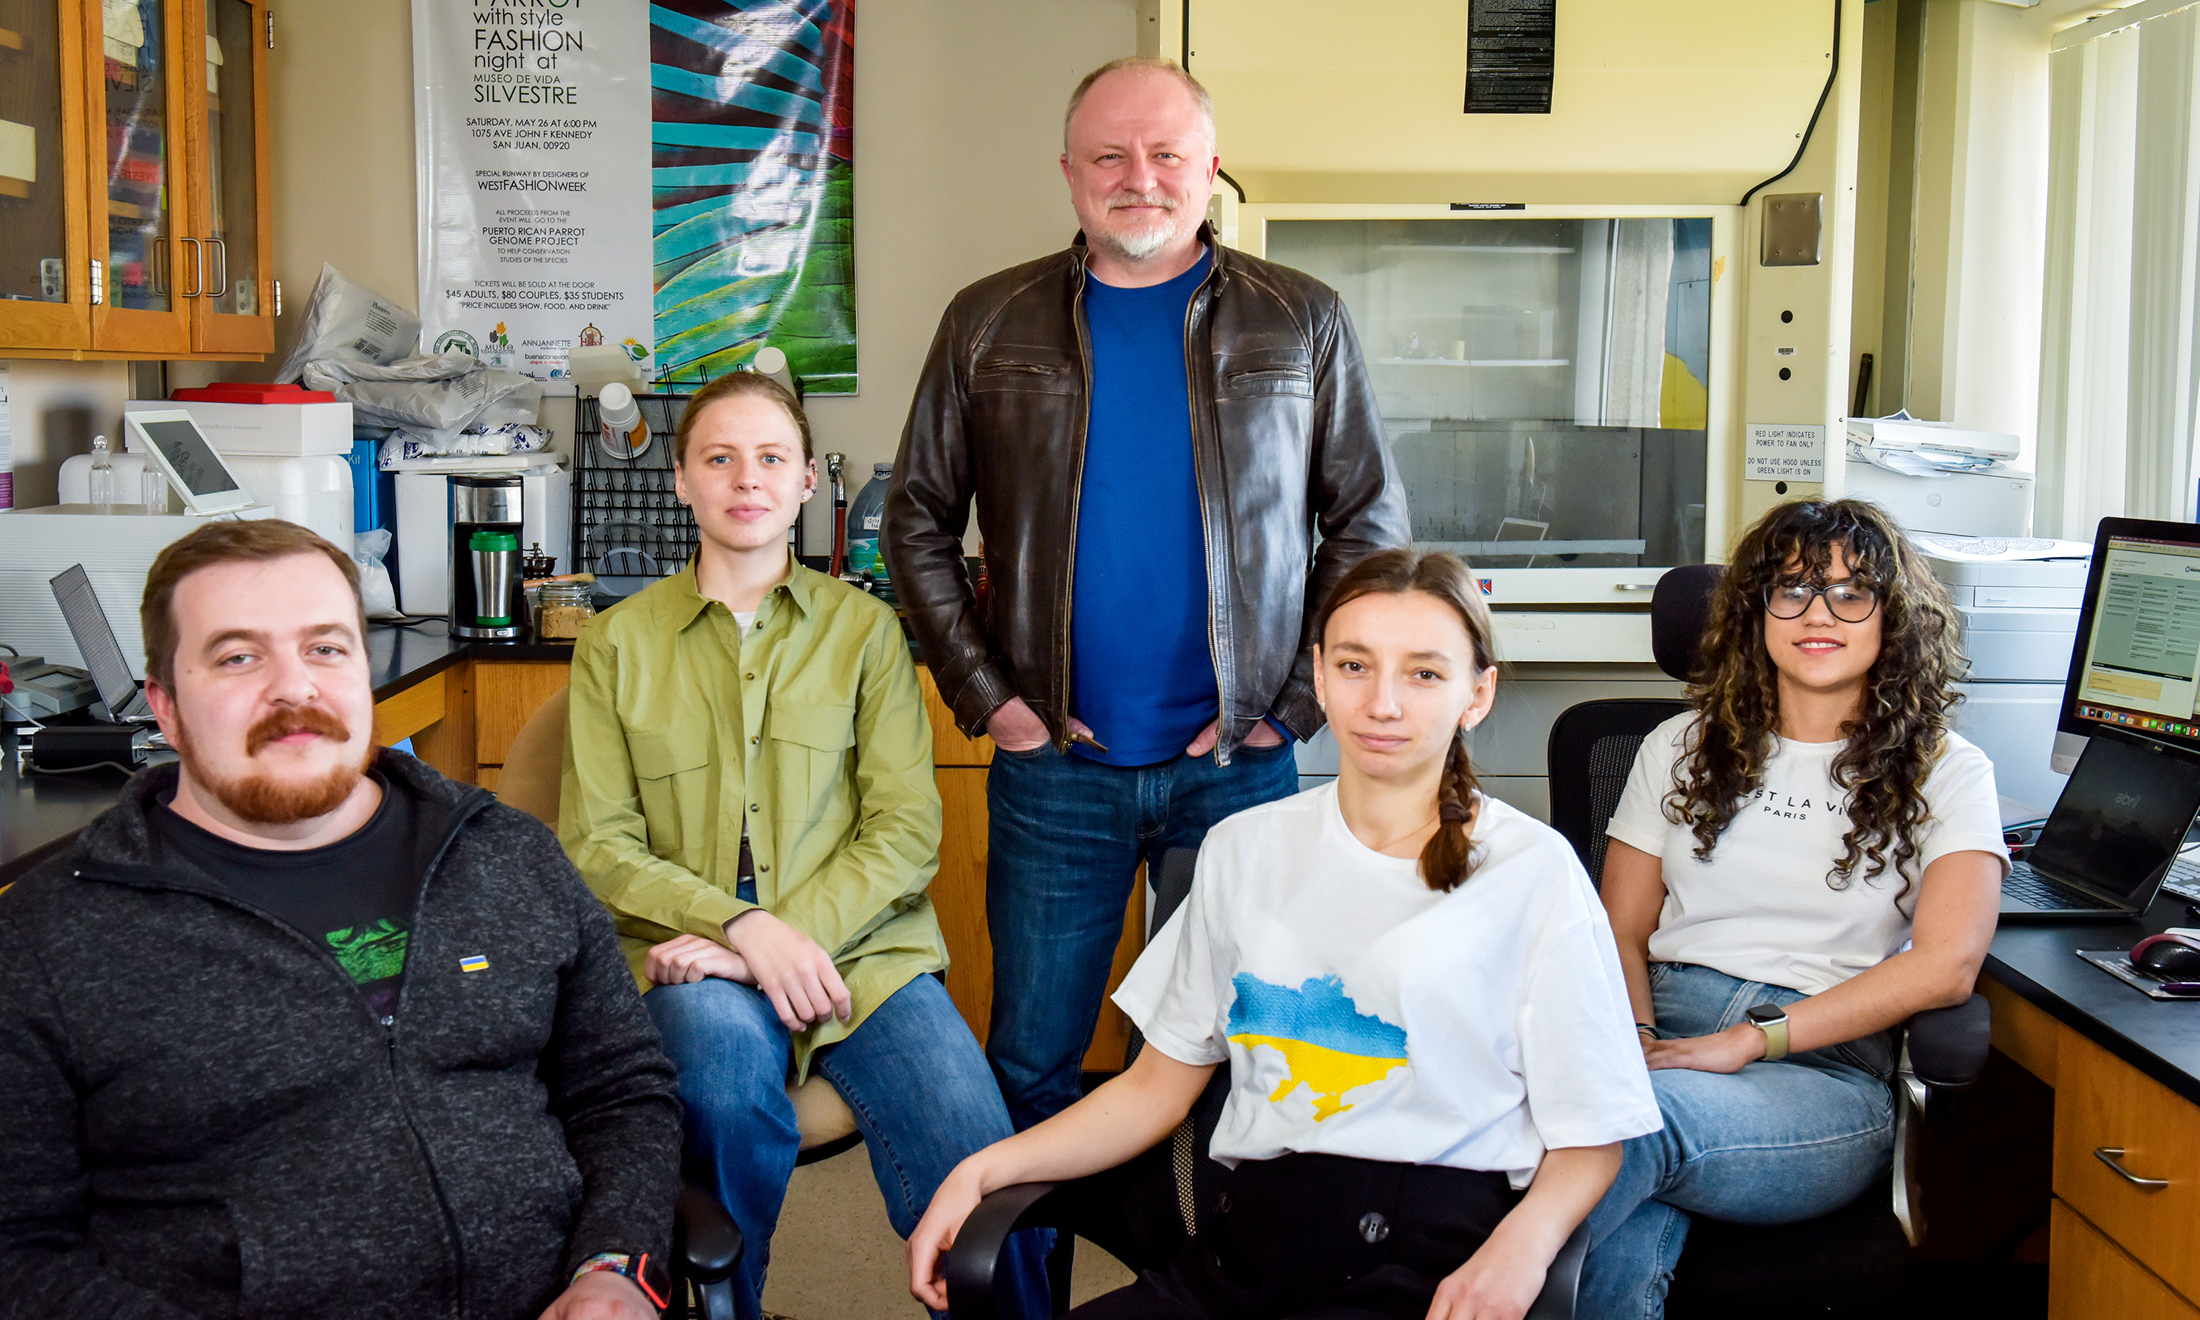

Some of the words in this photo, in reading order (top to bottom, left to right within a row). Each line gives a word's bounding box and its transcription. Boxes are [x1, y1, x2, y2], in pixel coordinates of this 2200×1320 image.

[473, 8, 514, 26] with
[520, 9, 564, 29] style
[475, 29, 583, 52] FASHION
[474, 52, 525, 72] night
[536, 52, 558, 70] at
[473, 73, 513, 84] MUSEO
[516, 74, 531, 84] DE
[533, 74, 561, 85] VIDA
[474, 84, 577, 105] SILVESTRE
[514, 118, 536, 127] MAY
[537, 118, 549, 128] 26
[550, 119, 562, 128] AT
[563, 119, 582, 128] 6:00
[582, 119, 598, 128] PM
[472, 128, 492, 138] 1075
[493, 129, 512, 138] AVE
[514, 129, 541, 139] JOHN
[543, 129, 548, 138] F
[550, 130, 593, 140] KENNEDY
[492, 140, 512, 150] SAN
[542, 141, 571, 151] 00920
[475, 169, 501, 178] SPECIAL
[502, 170, 532, 178] RUNWAY
[532, 170, 541, 178] BY
[542, 170, 579, 179] DESIGNERS
[579, 171, 590, 179] OF
[477, 179, 587, 192] WESTFASHIONWEEK
[540, 209, 559, 217] FROM
[560, 209, 571, 217] THE
[498, 216, 517, 224] EVENT
[534, 216, 546, 224] GO
[482, 226, 516, 238] PUERTO
[518, 227, 547, 238] RICAN
[549, 227, 586, 239] PARROT
[488, 236, 532, 246] GENOME
[535, 236, 579, 246] PROJECT
[497, 247, 506, 255] TO
[506, 247, 521, 255] HELP
[499, 256, 522, 264] STUDIES
[522, 256, 532, 264] OF
[532, 256, 544, 264] THE
[544, 256, 569, 264] SPECIES
[474, 280, 501, 288] TICKETS
[501, 280, 517, 288] WILL
[518, 280, 527, 288] BE
[527, 280, 547, 289] SOLD
[558, 281, 571, 289] THE
[571, 281, 595, 289] DOOR
[445, 289, 462, 299] $45
[501, 290, 517, 300] $80
[563, 290, 580, 301] $35
[581, 291, 624, 301] STUDENTS
[483, 301, 518, 310] INCLUDES
[568, 303, 586, 311] AND
[1755, 430, 1767, 438] RED
[1768, 430, 1784, 438] LIGHT
[1786, 430, 1815, 439] INDICATES
[1756, 439, 1775, 447] POWER
[1777, 439, 1785, 447] TO
[1785, 439, 1797, 448] FAN
[1798, 440, 1814, 448] ONLY
[348, 454, 361, 464] Kit
[1748, 457, 1755, 465] DO
[1756, 457, 1768, 465] NOT
[1769, 457, 1781, 466] USE
[1782, 458, 1798, 466] HOOD
[1799, 459, 1821, 467] UNLESS
[1757, 466, 1775, 475] GREEN
[1777, 467, 1793, 475] LIGHT
[1795, 468, 1801, 476] IS
[1802, 468, 1811, 476] ON
[1787, 796, 1811, 808] LA
[1826, 802, 1842, 816] VI
[1763, 805, 1807, 821] PARIS
